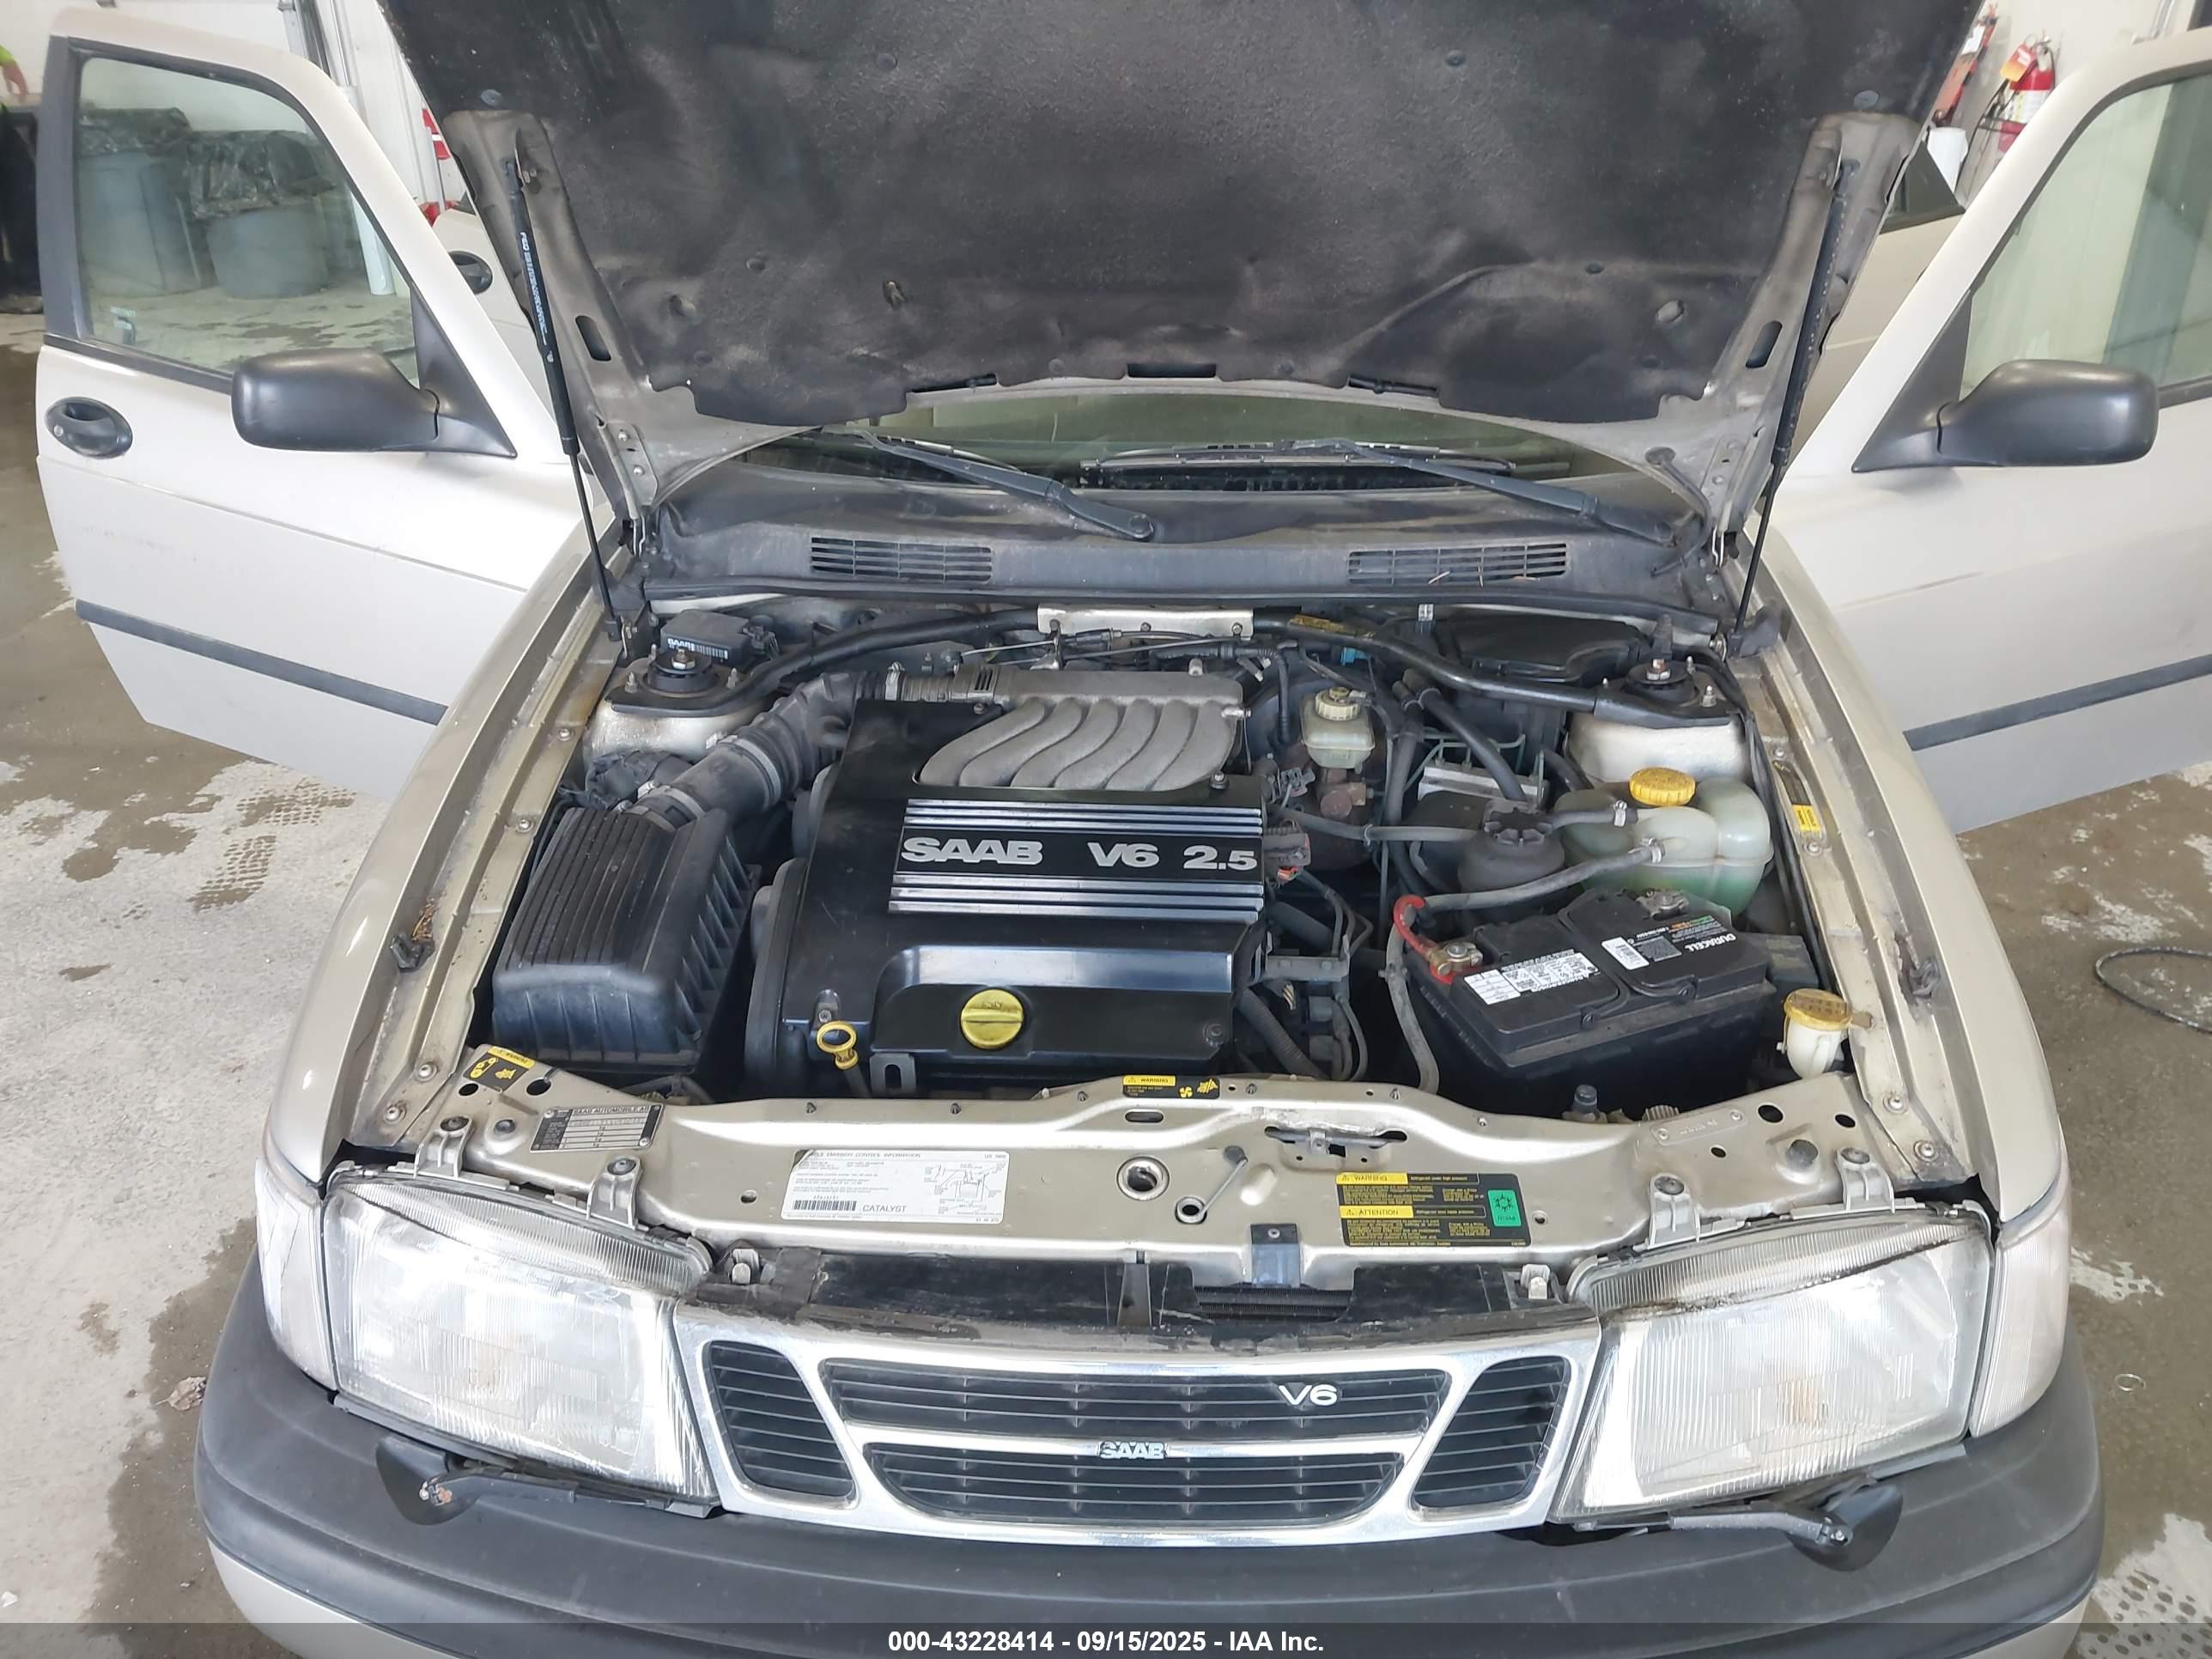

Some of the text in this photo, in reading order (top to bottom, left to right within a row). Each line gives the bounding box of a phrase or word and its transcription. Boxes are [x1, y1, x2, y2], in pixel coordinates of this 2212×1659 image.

[901, 837, 1258, 871] SAAB V6 2.5
[1685, 933, 1736, 952] DURACELL
[862, 1204, 907, 1212] CATALYST
[1278, 1384, 1338, 1406] V6
[1100, 1442, 1164, 1460] SAAB
